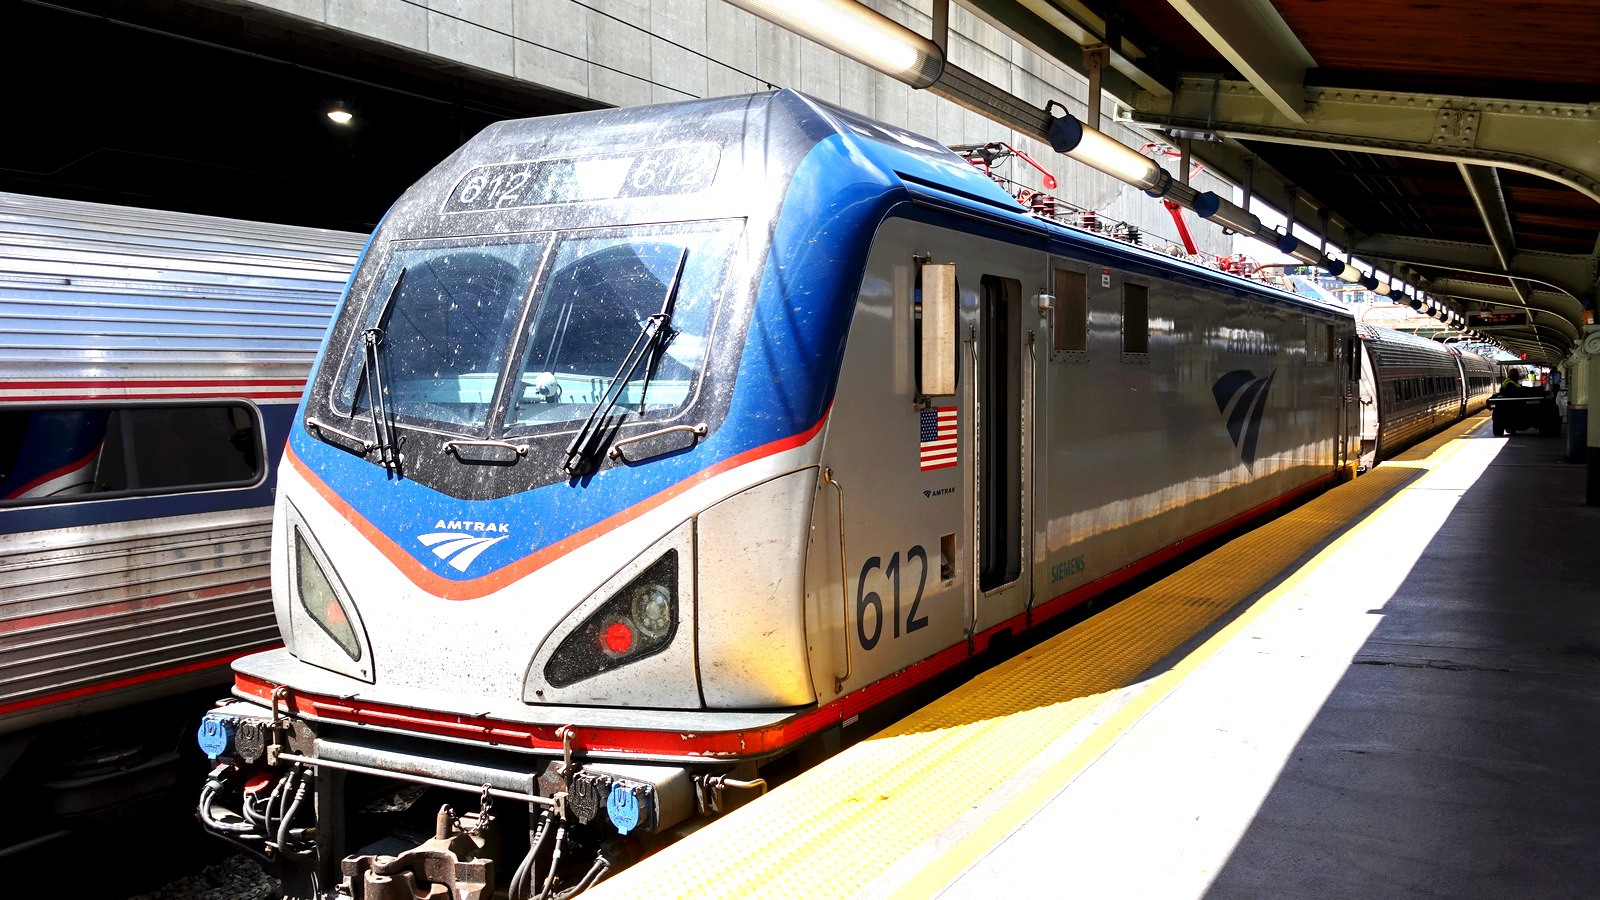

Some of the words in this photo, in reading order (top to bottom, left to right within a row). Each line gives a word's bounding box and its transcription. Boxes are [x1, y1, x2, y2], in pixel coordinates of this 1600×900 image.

[632, 155, 704, 189] 612
[460, 172, 531, 204] 612
[1227, 331, 1276, 356] AMTRAK
[932, 487, 956, 497] AMTRAK
[435, 520, 509, 532] AMTRAK
[1051, 554, 1085, 584] SIEMENS
[857, 545, 929, 650] 612
